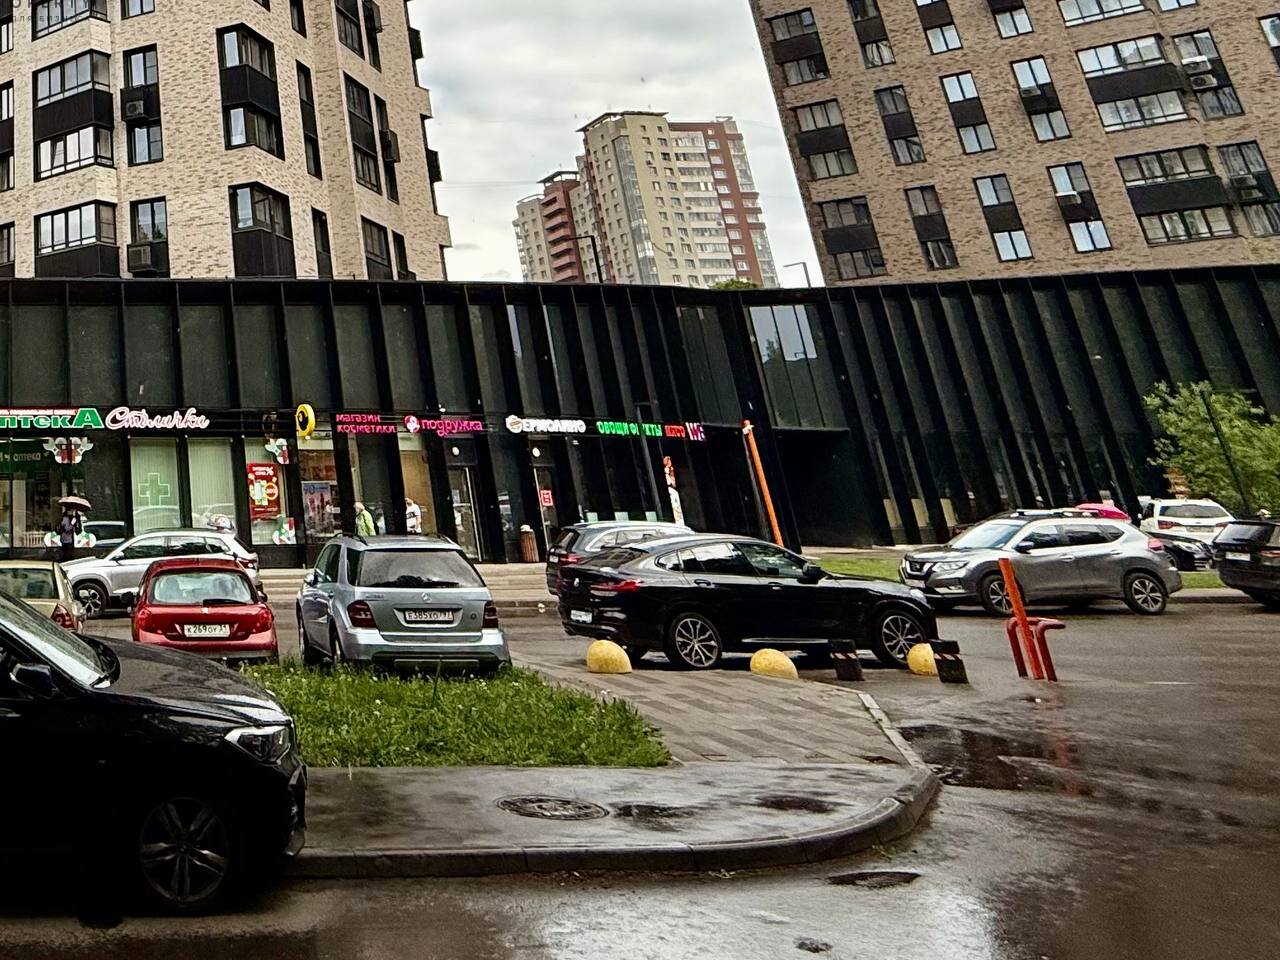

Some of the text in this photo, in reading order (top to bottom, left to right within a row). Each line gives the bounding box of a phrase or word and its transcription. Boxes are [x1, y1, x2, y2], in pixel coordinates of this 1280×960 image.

[105, 406, 210, 430] Столички
[422, 418, 483, 436] подружка
[523, 418, 587, 434] ЕРМОЛИНО
